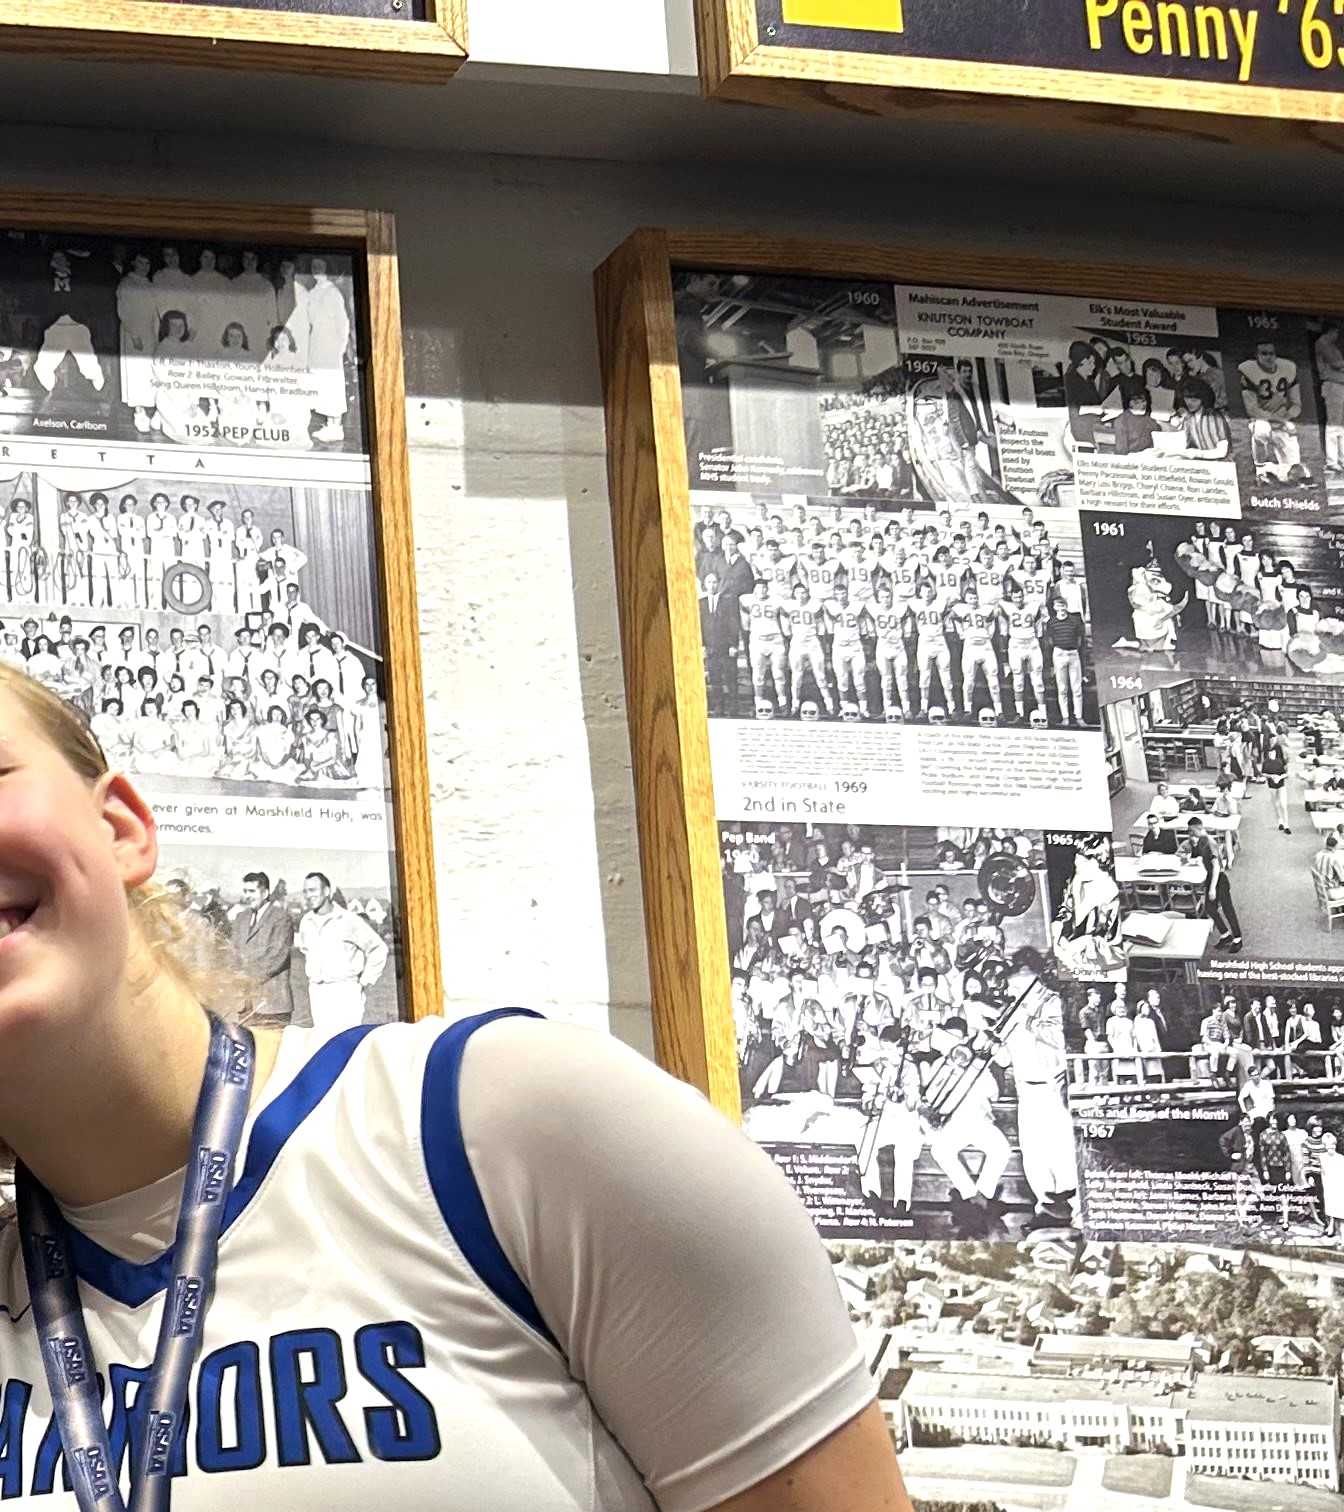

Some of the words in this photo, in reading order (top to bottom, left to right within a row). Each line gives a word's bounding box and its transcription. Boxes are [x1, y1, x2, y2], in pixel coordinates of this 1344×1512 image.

[1085, 0, 1258, 82] Penny
[847, 291, 881, 306] 1960
[961, 295, 1040, 312] Advertisement
[1114, 305, 1140, 317] Most
[1140, 307, 1186, 320] Valuable
[917, 312, 973, 325] KNUTSON
[976, 315, 1035, 329] TOWBOAT
[1100, 316, 1139, 329] Student
[1141, 320, 1178, 332] Award
[1247, 316, 1279, 329] 1965
[946, 326, 1008, 340] COMPANY
[1126, 333, 1158, 345] 1963
[905, 360, 938, 374] 1967
[184, 424, 221, 438] 1952
[223, 426, 249, 440] PEP
[252, 427, 290, 441] CLUB
[1250, 496, 1282, 510] Butch
[1282, 497, 1321, 512] Shields
[1093, 522, 1125, 536] 1961
[1108, 675, 1144, 692] 1964
[833, 781, 868, 794] 1969
[152, 803, 179, 814] ever
[184, 804, 219, 818] given
[225, 804, 238, 816] at
[245, 804, 313, 819] Marshfield
[319, 808, 354, 823] High,
[361, 812, 384, 822] was
[743, 796, 776, 813] 2nd
[780, 797, 798, 813] in
[801, 799, 847, 815] State
[721, 831, 745, 845] Pep
[746, 831, 776, 845] Band
[1045, 833, 1076, 847] 1965
[1078, 1107, 1105, 1119] Girls
[1106, 1108, 1128, 1119] and
[1171, 1108, 1191, 1120] the
[1191, 1109, 1230, 1121] Month
[1081, 1125, 1116, 1139] 1967
